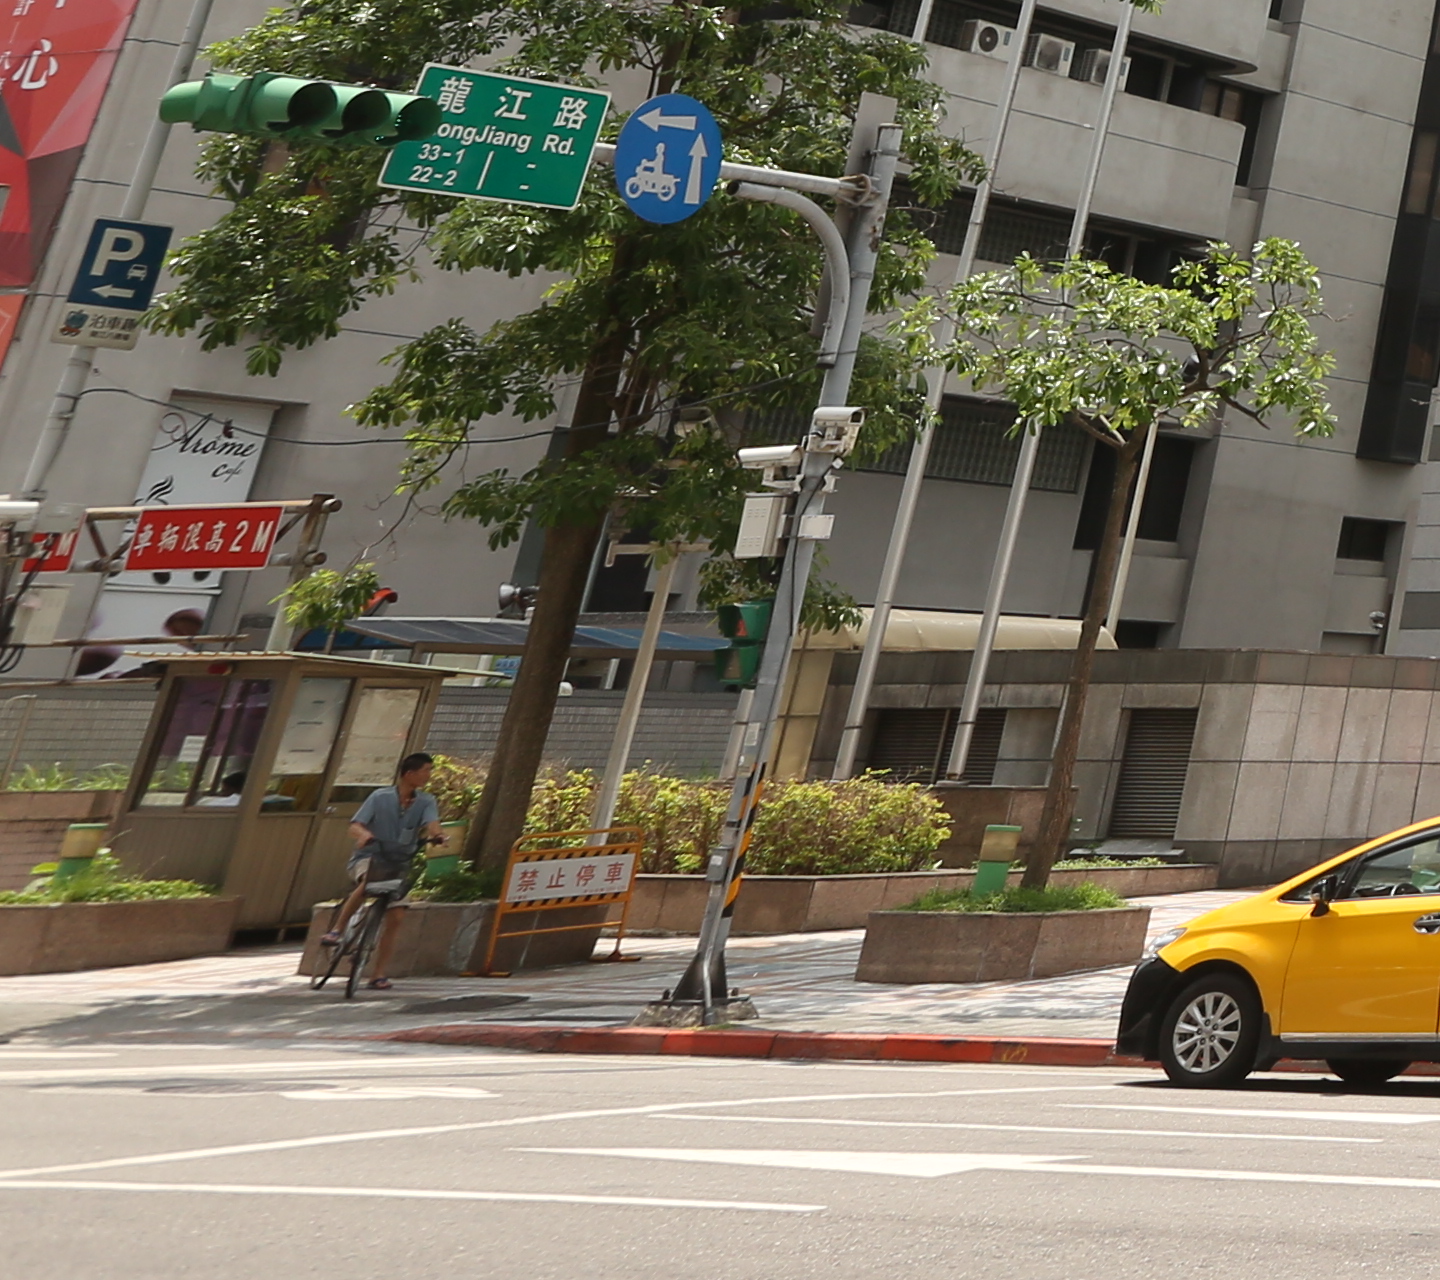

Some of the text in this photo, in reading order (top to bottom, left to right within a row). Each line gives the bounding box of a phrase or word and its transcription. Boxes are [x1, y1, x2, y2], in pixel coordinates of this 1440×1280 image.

[437, 76, 589, 130] 龍江路
[418, 143, 466, 165] 33-1
[434, 122, 576, 156] ongJiang Rd.
[408, 164, 458, 187] 22-2
[89, 227, 145, 277] P
[516, 861, 625, 892] 禁止停車
